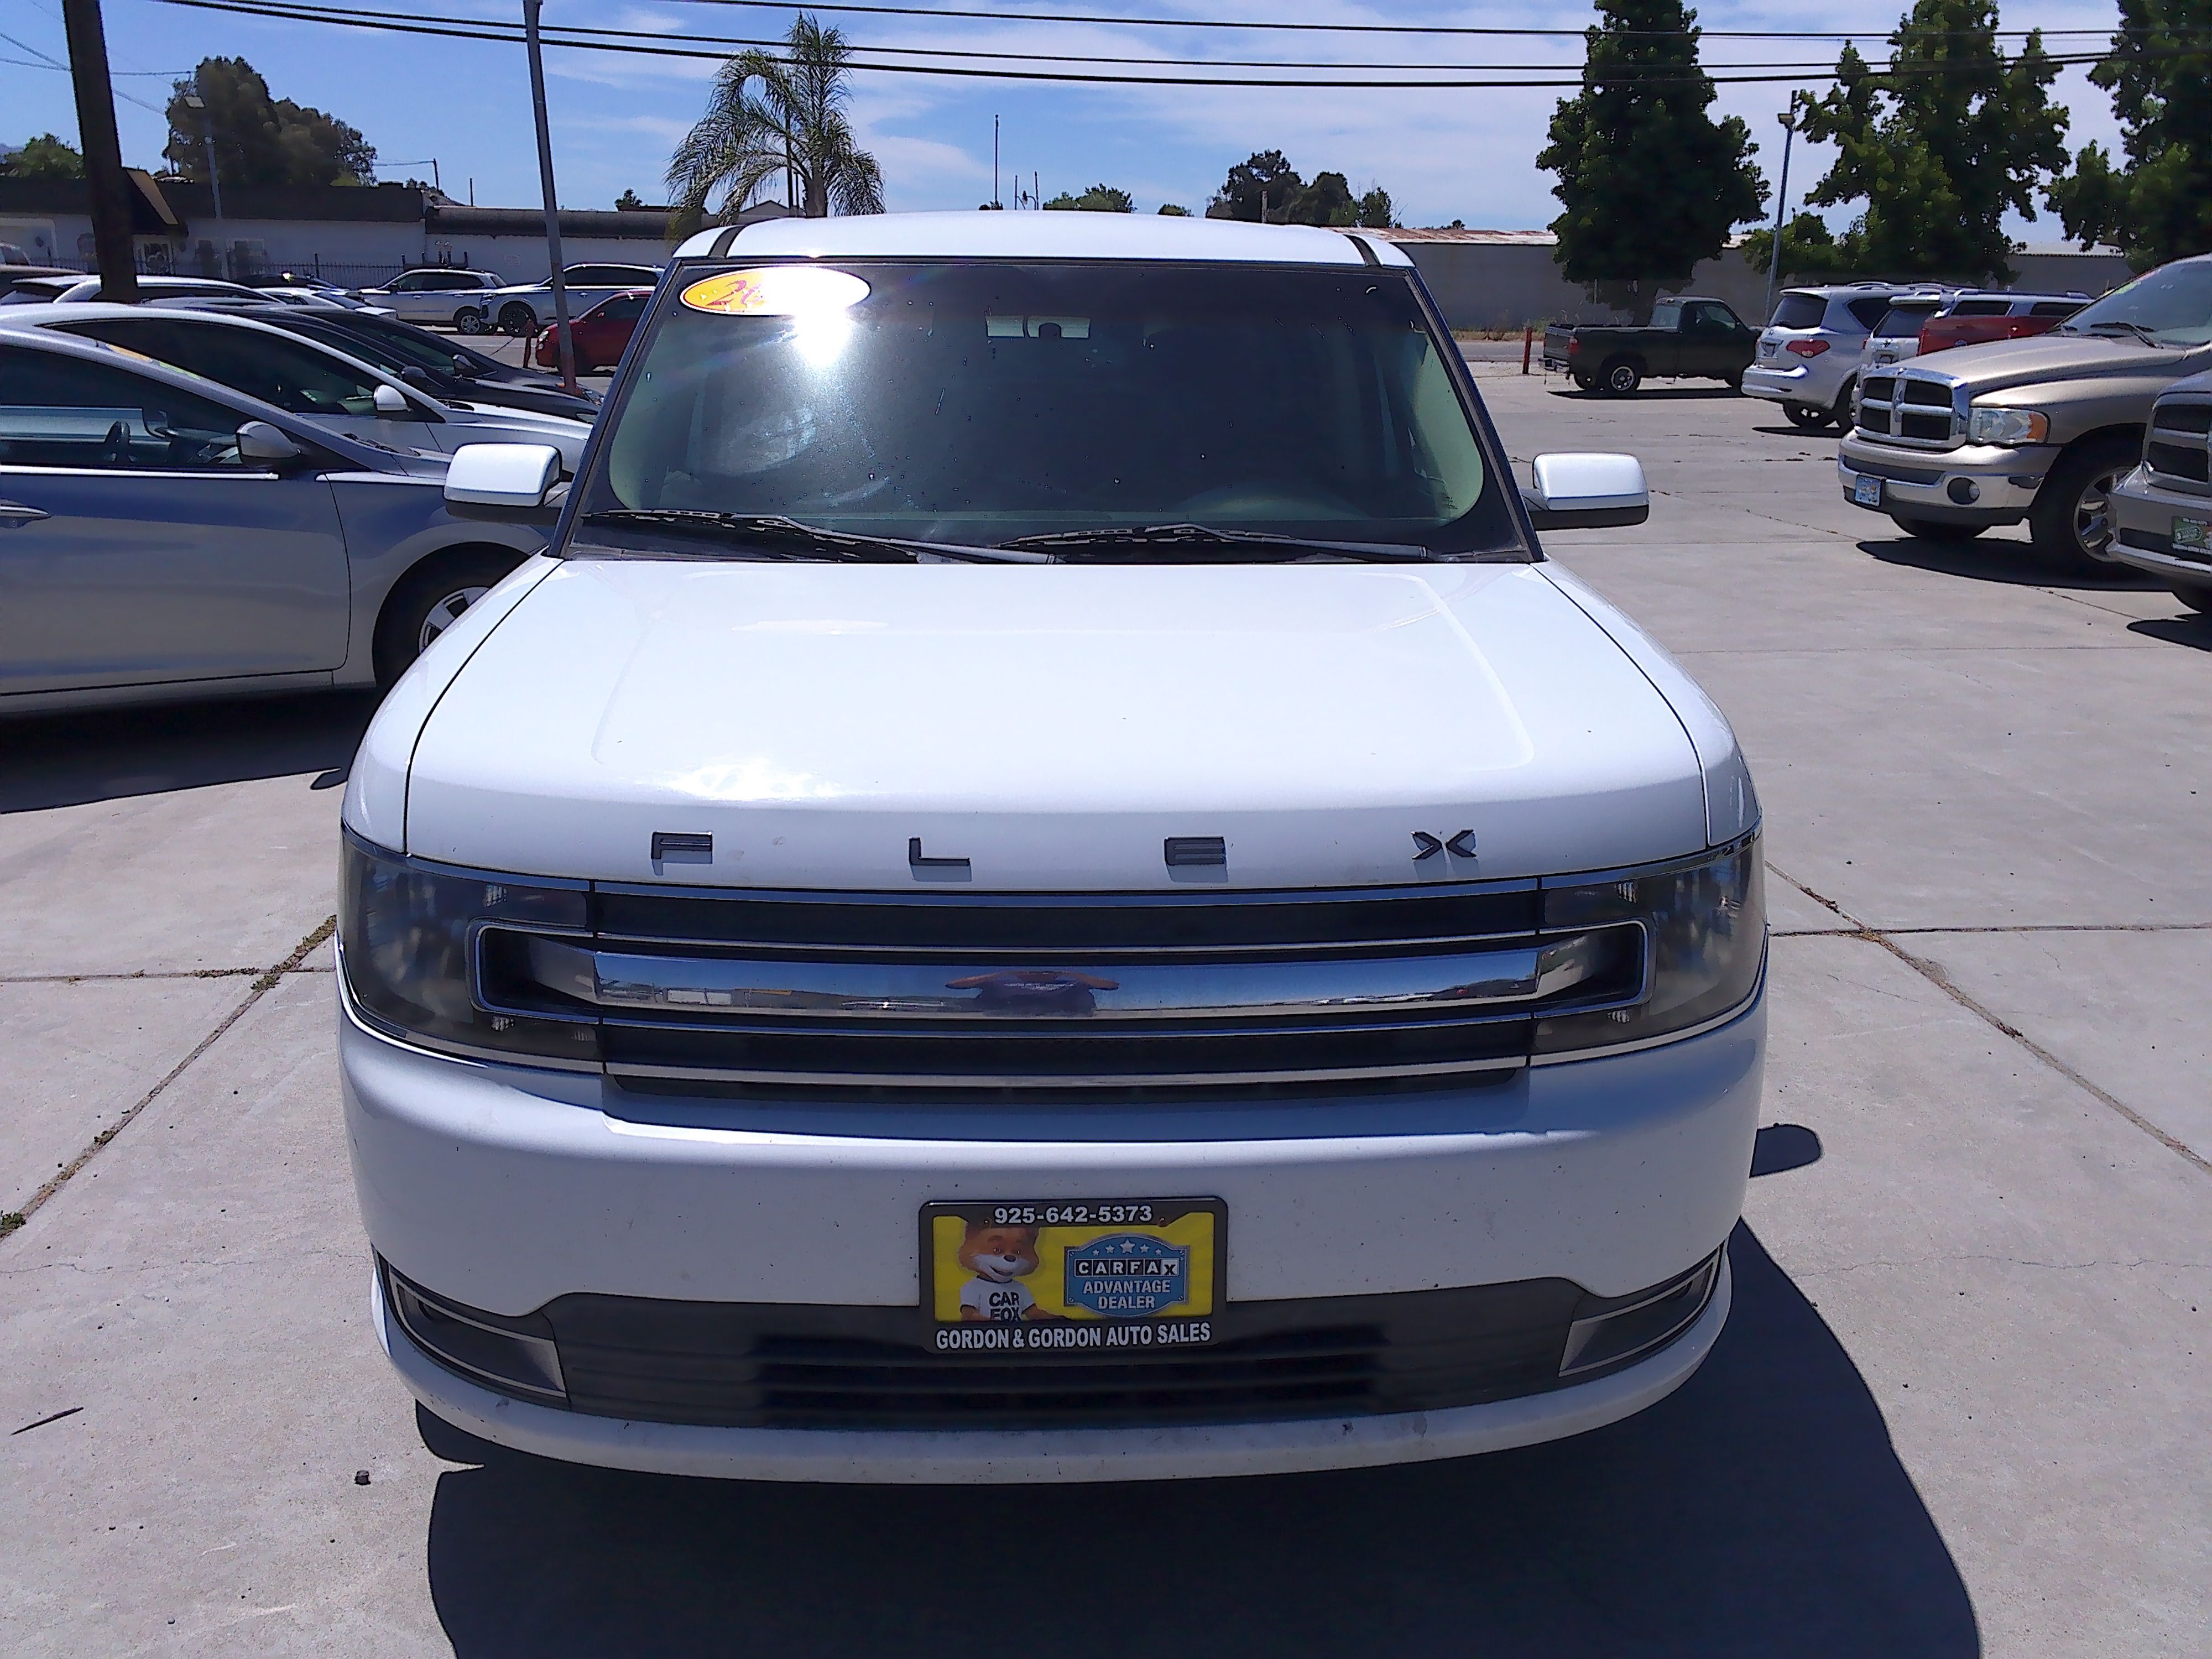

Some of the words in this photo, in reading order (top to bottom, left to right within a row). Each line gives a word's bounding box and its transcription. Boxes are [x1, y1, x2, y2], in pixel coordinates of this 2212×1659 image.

[651, 830, 1477, 867] FLEX
[994, 1206, 1152, 1224] 925-642-5373
[1078, 1260, 1177, 1276] CARFAX
[1083, 1279, 1171, 1295] ADVANTAGE
[989, 1291, 1020, 1307] CAR
[1098, 1295, 1156, 1310] DEALER
[990, 1307, 1022, 1322] FOX
[936, 1328, 1009, 1349] GORDON
[1012, 1328, 1025, 1348] &
[1028, 1327, 1101, 1348] GORDON
[1106, 1325, 1152, 1347] AUTO
[1156, 1322, 1211, 1345] SALES
